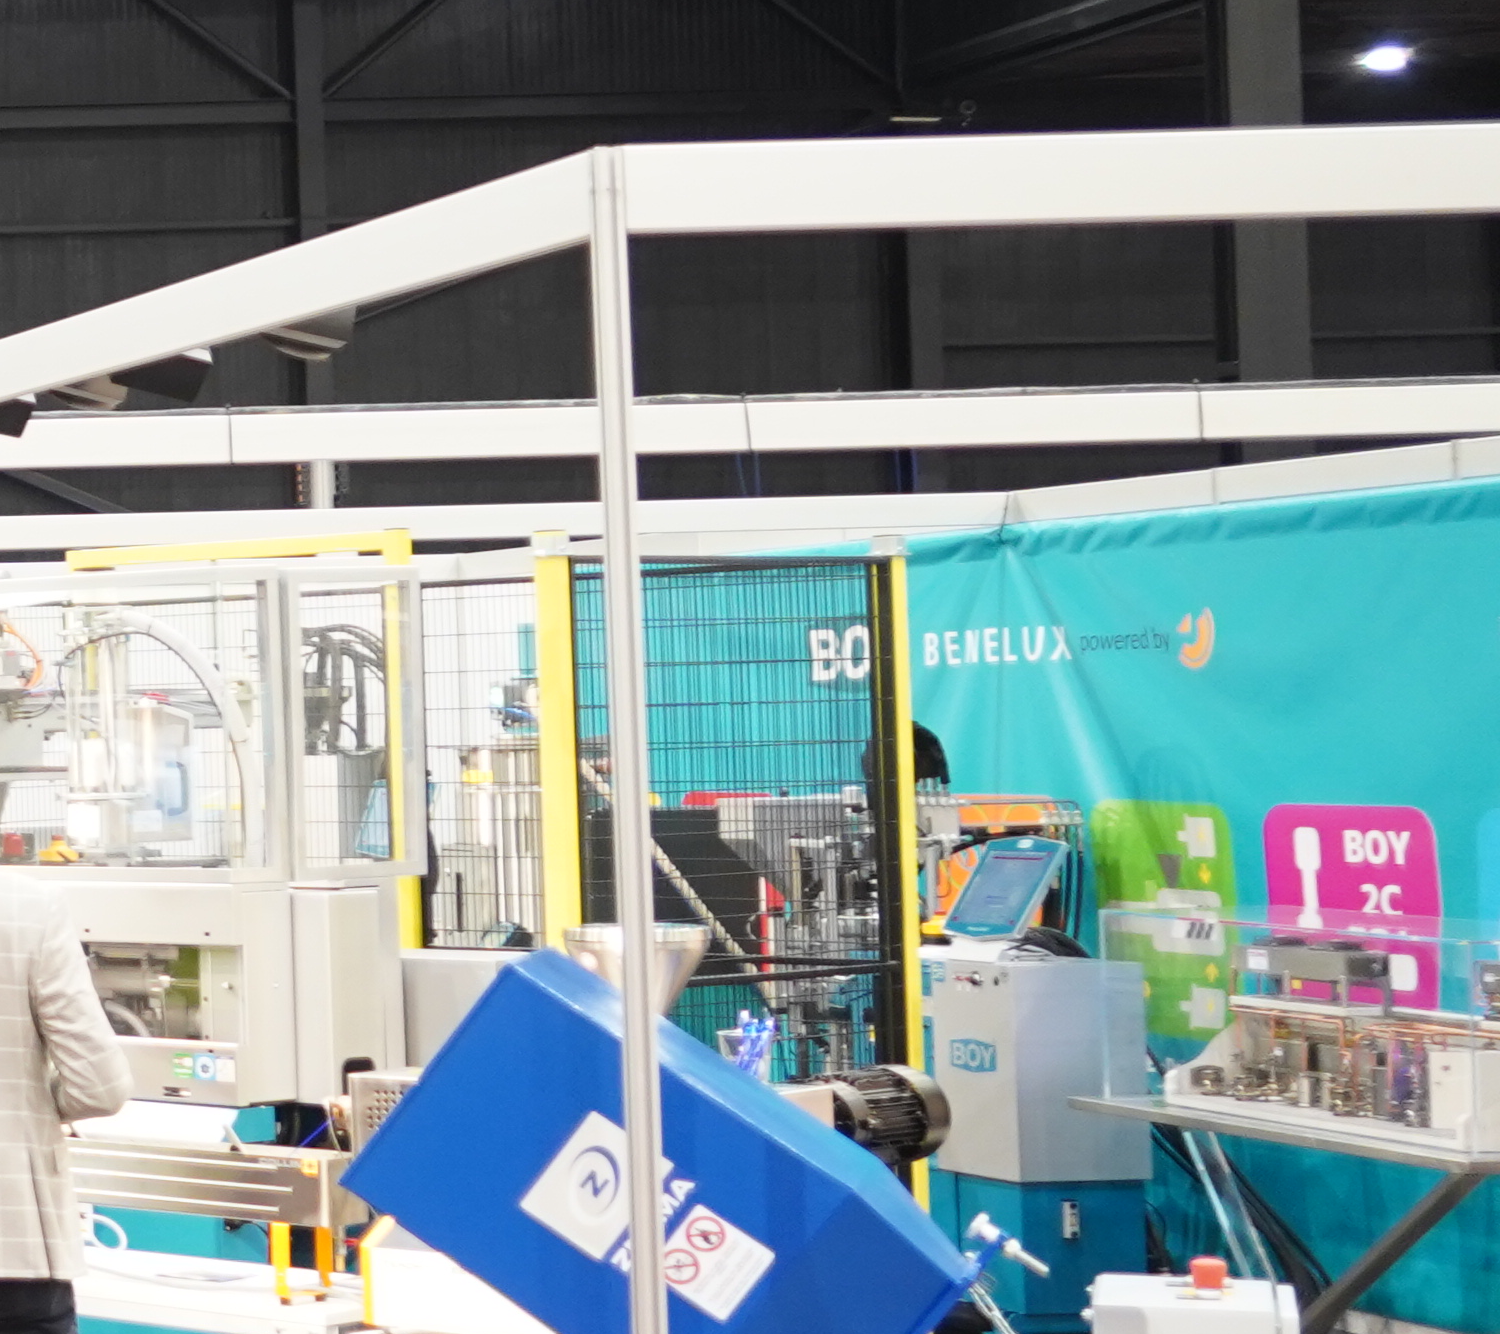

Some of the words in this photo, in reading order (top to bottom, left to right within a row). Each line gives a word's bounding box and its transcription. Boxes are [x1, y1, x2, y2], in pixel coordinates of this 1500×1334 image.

[809, 625, 871, 683] BO
[923, 624, 1073, 667] BENELUX
[1080, 631, 1149, 654] powered
[1152, 629, 1171, 653] by
[1343, 829, 1412, 866] BOY
[1359, 883, 1403, 916] 2C
[952, 1041, 996, 1069] BOY
[611, 1177, 697, 1273] ZMA
